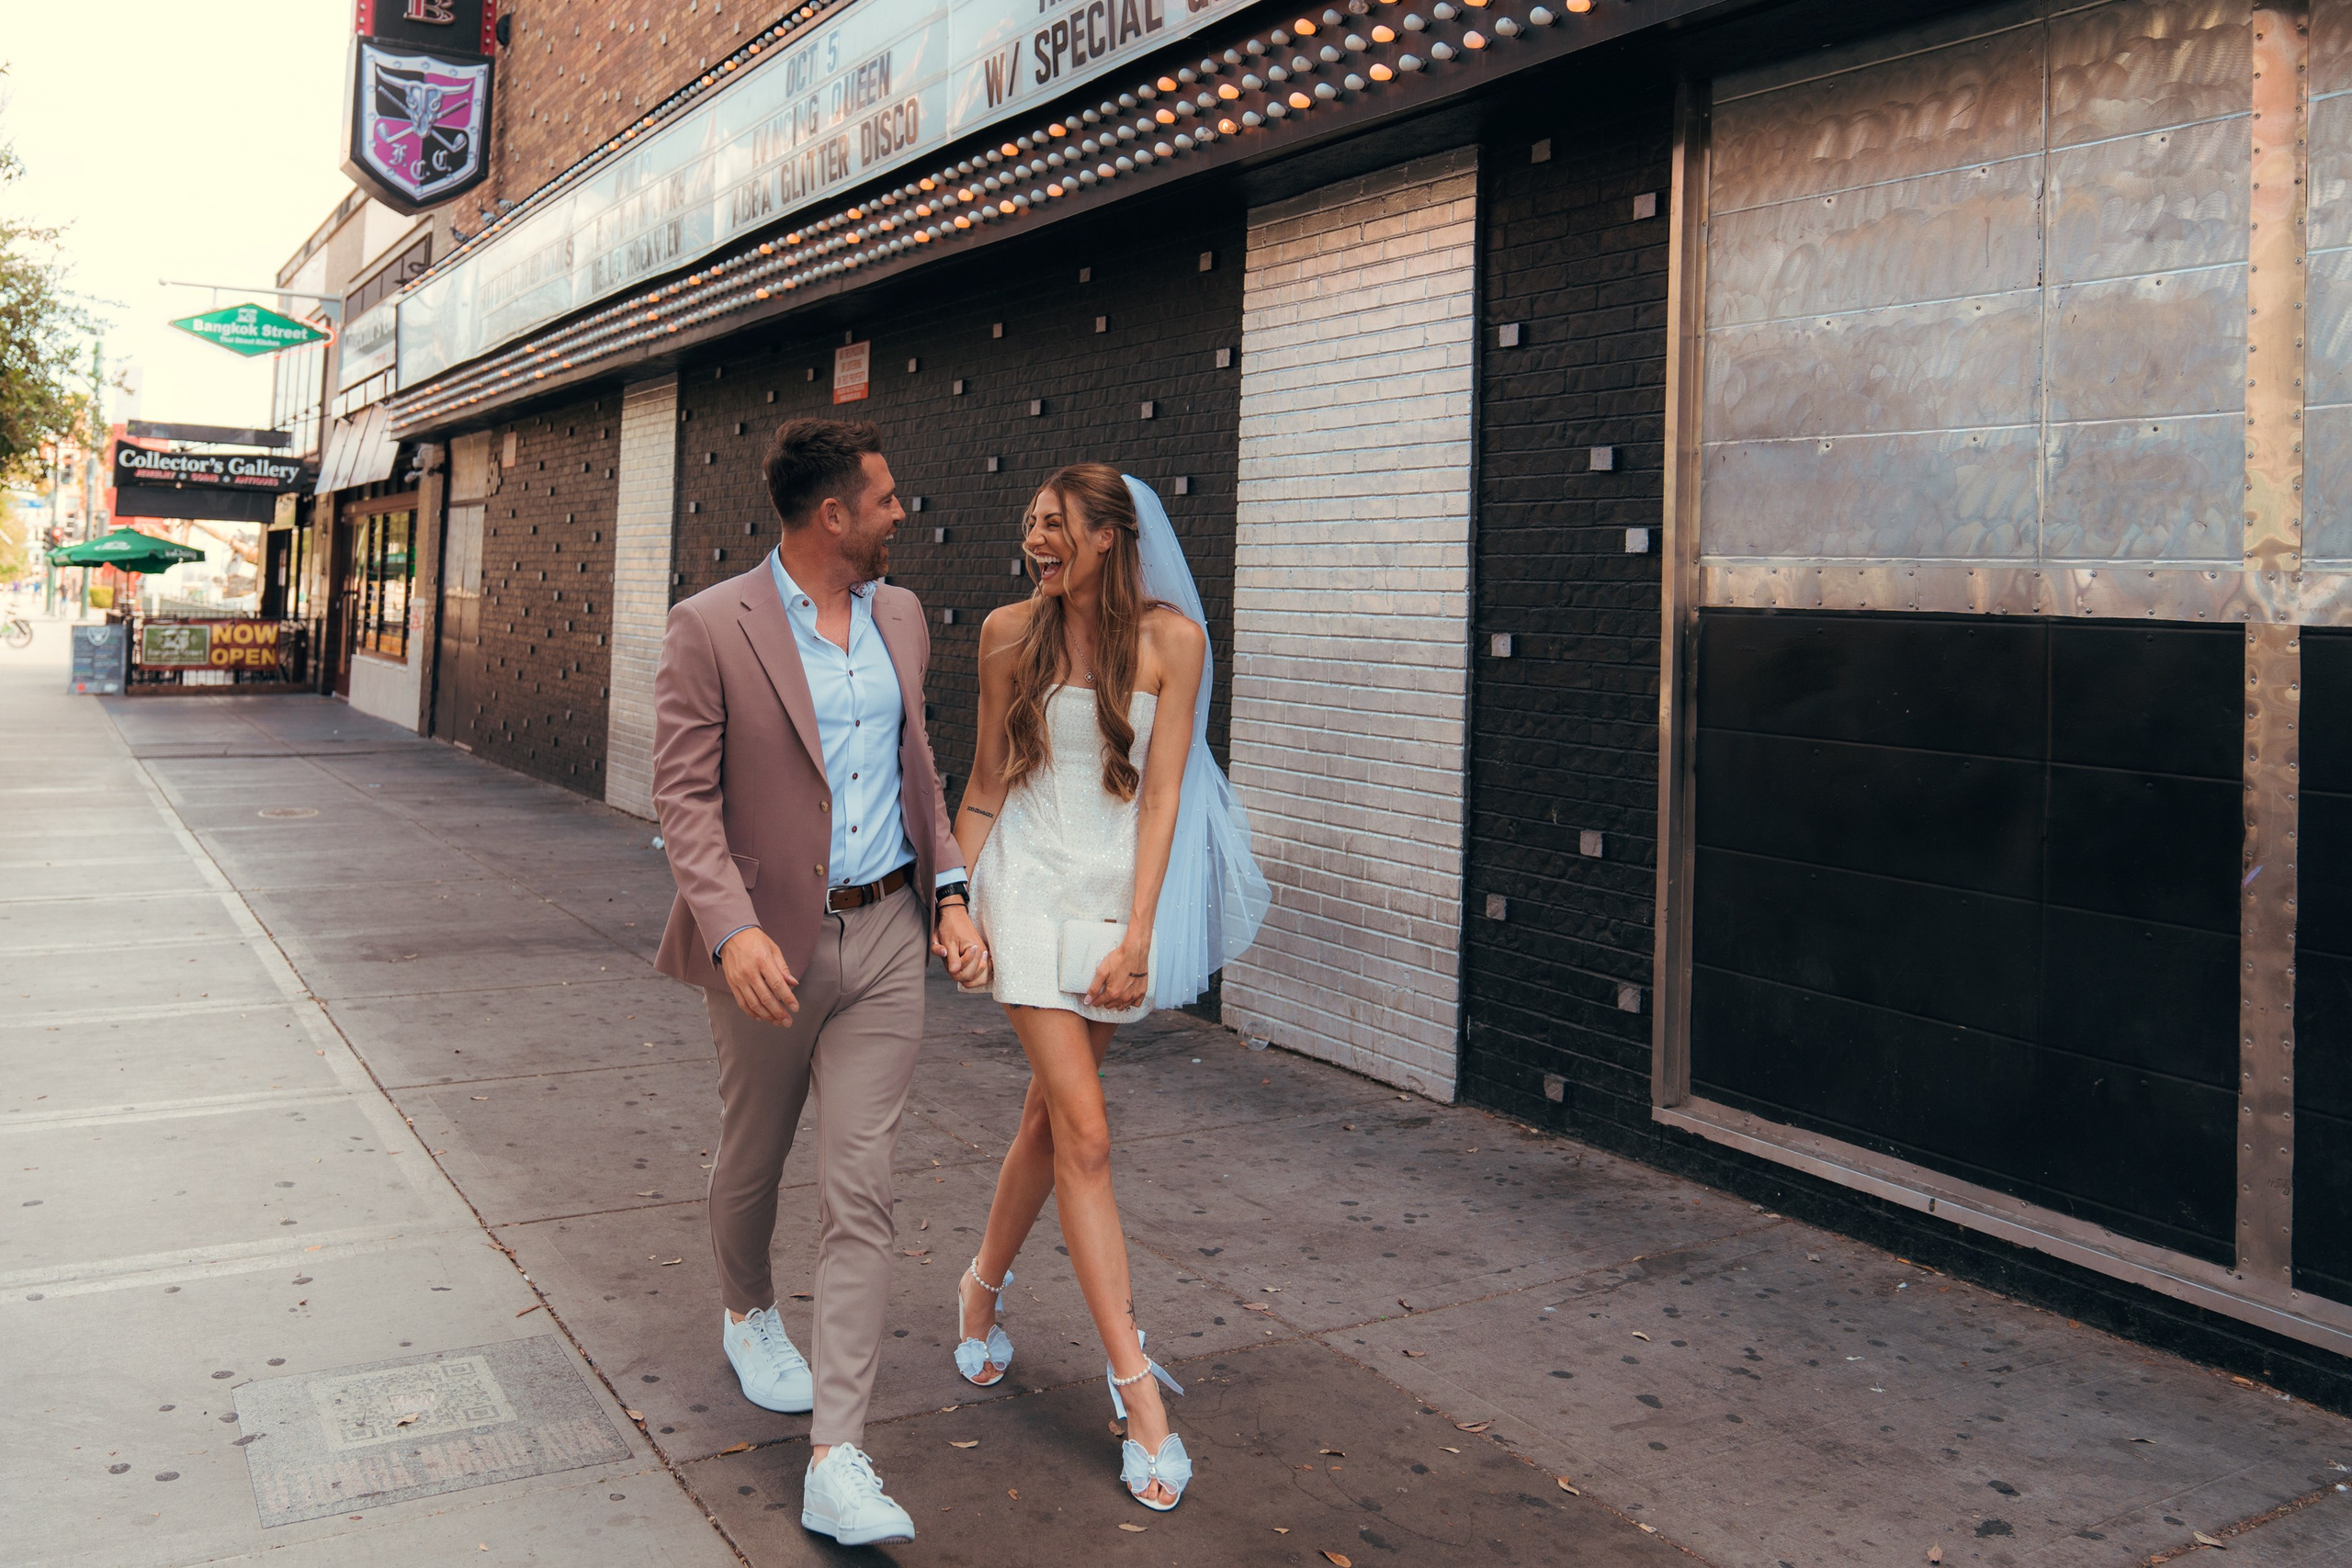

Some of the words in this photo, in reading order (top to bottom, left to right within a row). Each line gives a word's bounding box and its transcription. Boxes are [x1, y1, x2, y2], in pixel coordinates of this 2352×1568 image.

[786, 42, 818, 98] OCT
[827, 29, 839, 73] 5
[984, 40, 1020, 108] W/
[1035, 0, 1163, 85] SPECIAL
[831, 50, 892, 121] QUEEN
[732, 174, 773, 228] ABBA
[781, 134, 850, 206] GLITTER
[860, 97, 918, 167] DISCO
[193, 318, 258, 336] Bangkok
[261, 324, 308, 340] Street
[118, 449, 224, 473] Collector's
[228, 457, 300, 483] Gallery
[210, 648, 276, 666] OPEN
[212, 624, 279, 645] NOW
